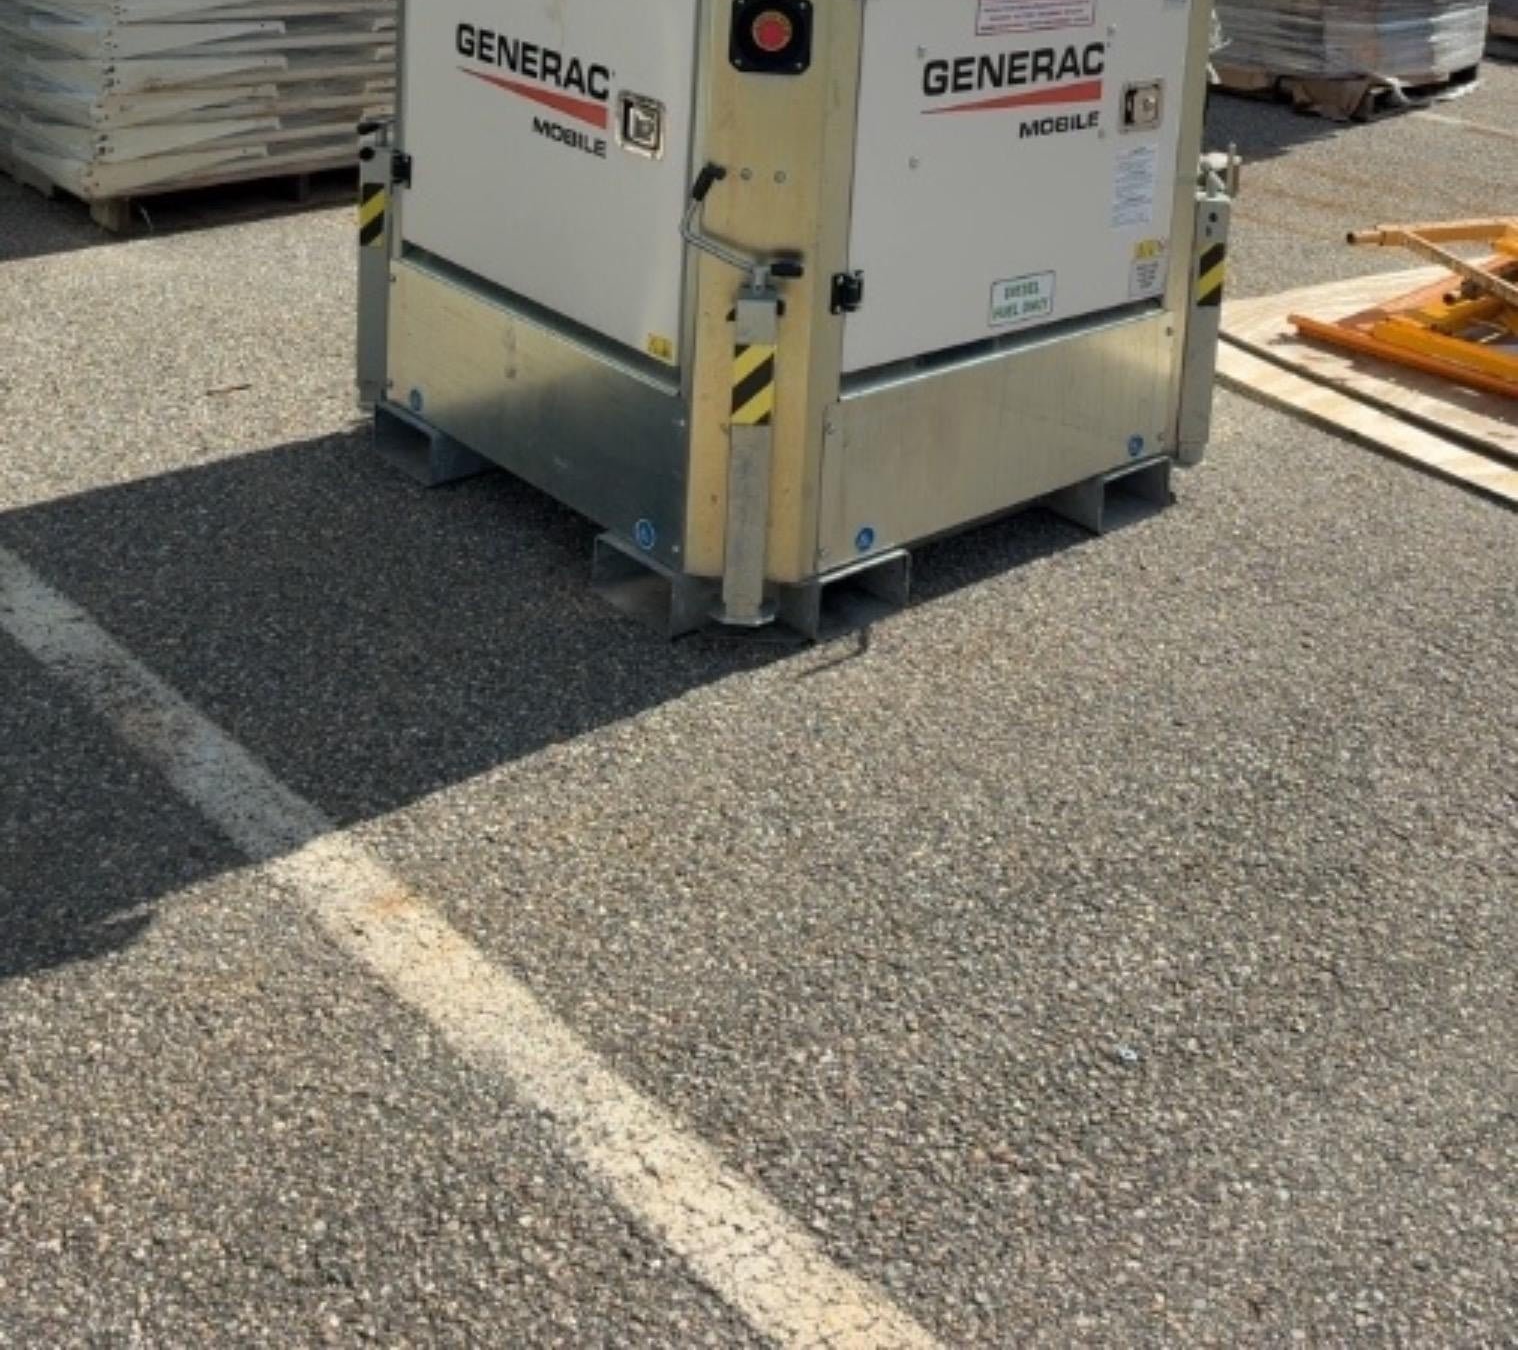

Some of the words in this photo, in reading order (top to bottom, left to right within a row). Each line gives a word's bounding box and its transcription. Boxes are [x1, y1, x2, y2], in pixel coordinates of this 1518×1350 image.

[456, 23, 610, 101] GENERAC
[923, 41, 1105, 96] GENERAC
[533, 116, 607, 159] MOBILE
[1019, 111, 1099, 139] MOBILE
